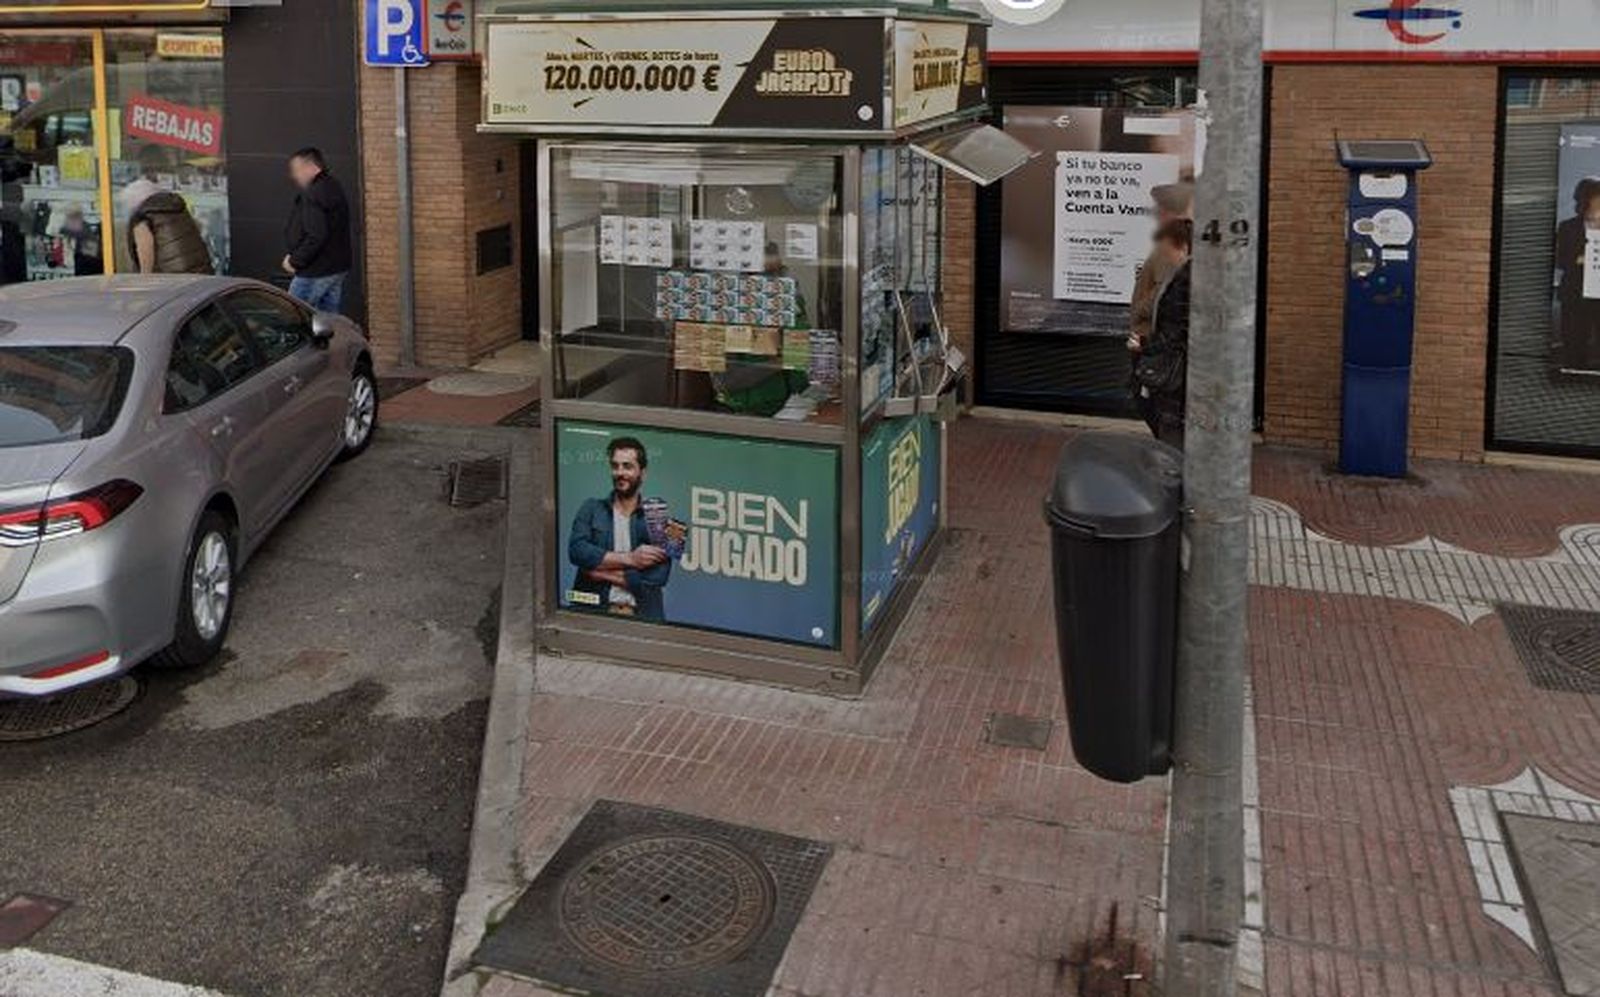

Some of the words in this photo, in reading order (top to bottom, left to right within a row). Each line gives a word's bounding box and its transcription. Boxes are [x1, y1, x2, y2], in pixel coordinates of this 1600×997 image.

[377, 0, 414, 55] P
[773, 48, 824, 71] EURO
[544, 64, 695, 91] 120.000.000
[702, 64, 721, 91] €
[756, 71, 845, 92] JACKPOT
[132, 105, 213, 146] REBAJAS
[1066, 158, 1079, 169] Si
[1081, 160, 1097, 169] tu
[1099, 159, 1143, 171] banco
[1066, 175, 1082, 185] ya
[1085, 175, 1101, 185] no
[1104, 175, 1118, 185] te
[1065, 189, 1091, 198] ven
[1094, 190, 1102, 199] a
[1105, 188, 1118, 199] la
[1064, 202, 1114, 214] Cuenta
[1118, 204, 1149, 216] Vam
[691, 486, 807, 538] BIEN
[681, 526, 807, 586] JUGADO
